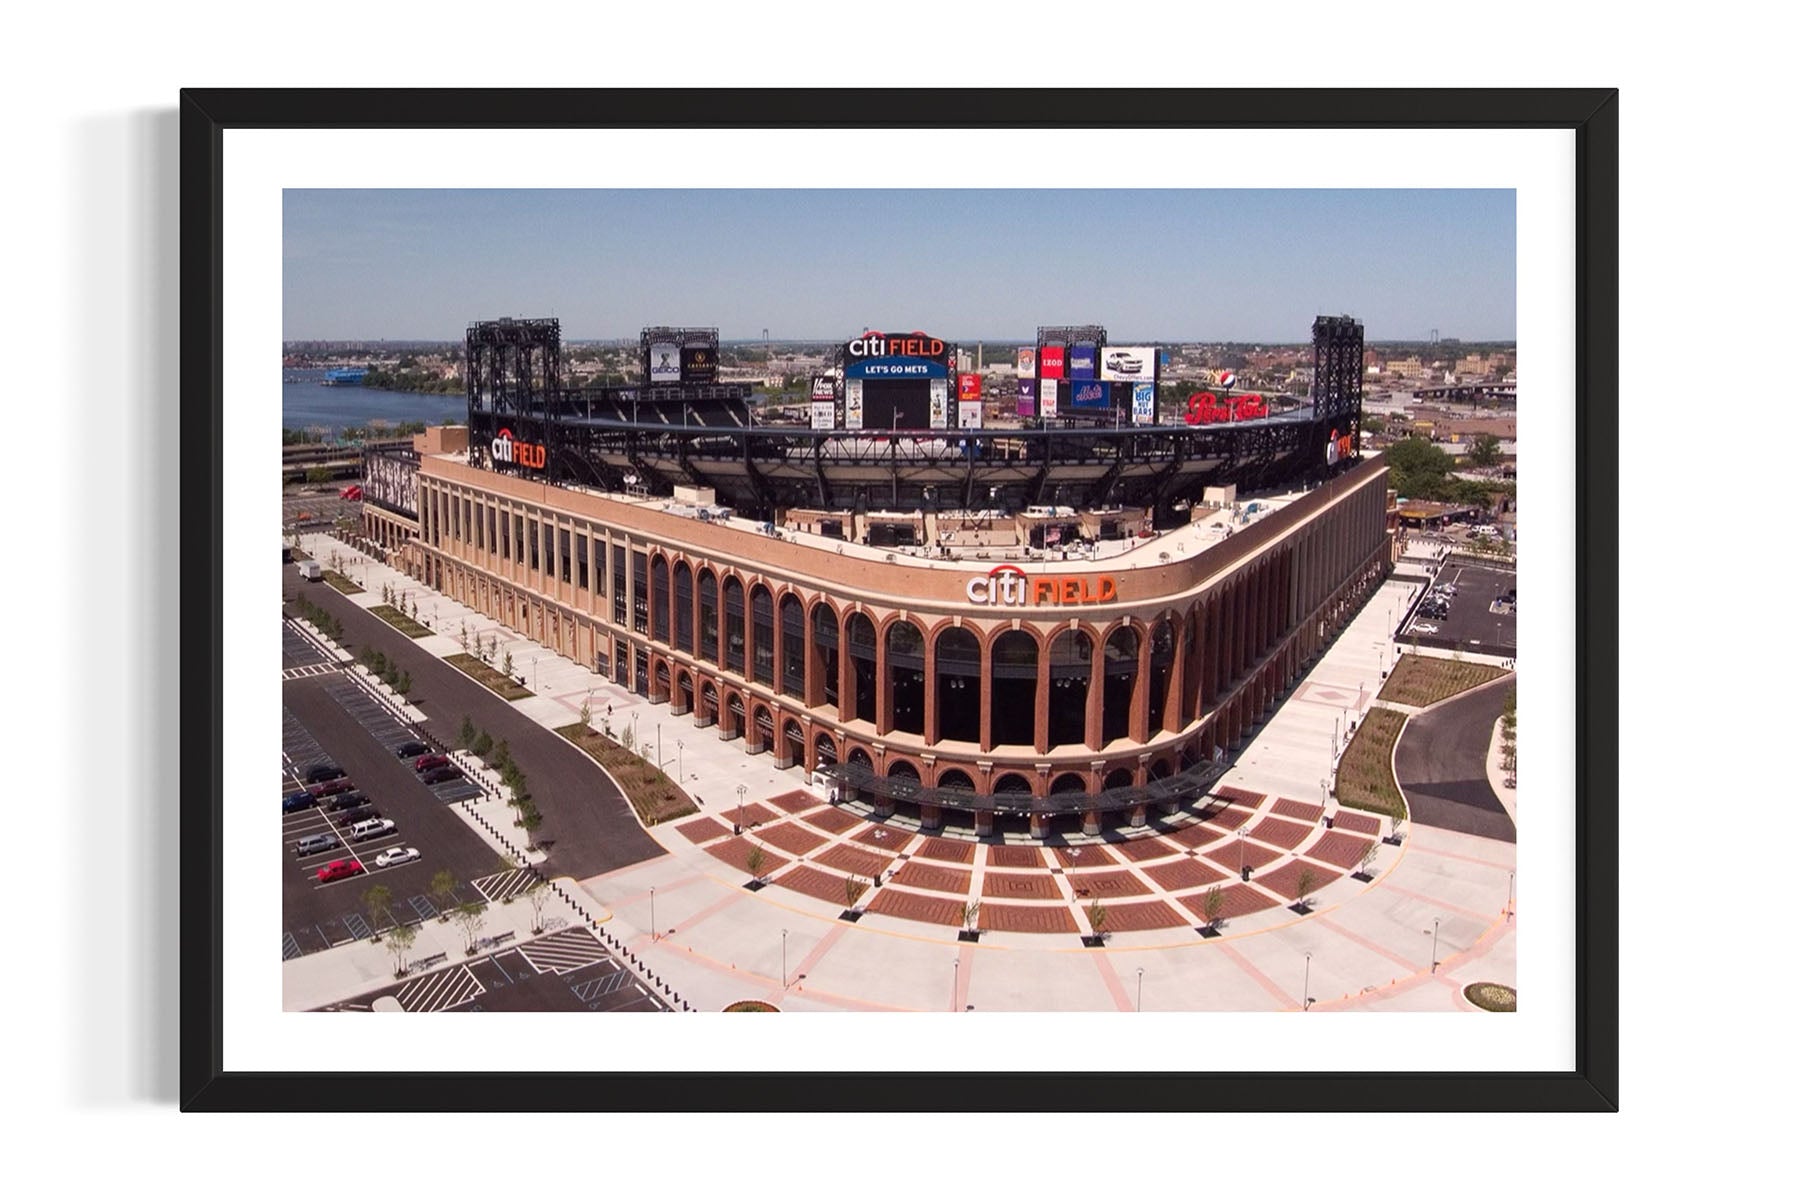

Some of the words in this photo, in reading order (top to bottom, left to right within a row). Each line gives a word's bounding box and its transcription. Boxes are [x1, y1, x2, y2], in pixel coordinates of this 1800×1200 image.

[889, 338, 944, 356] FIELD
[1043, 359, 1063, 367] IZOD
[651, 366, 680, 374] GEICO
[865, 365, 889, 374] LET'S
[890, 365, 903, 374] GO
[904, 365, 928, 374] METS
[1135, 391, 1151, 402] BIG
[513, 440, 546, 469] FIELD
[966, 571, 1026, 604] citi
[1034, 575, 1117, 605] FIELD
